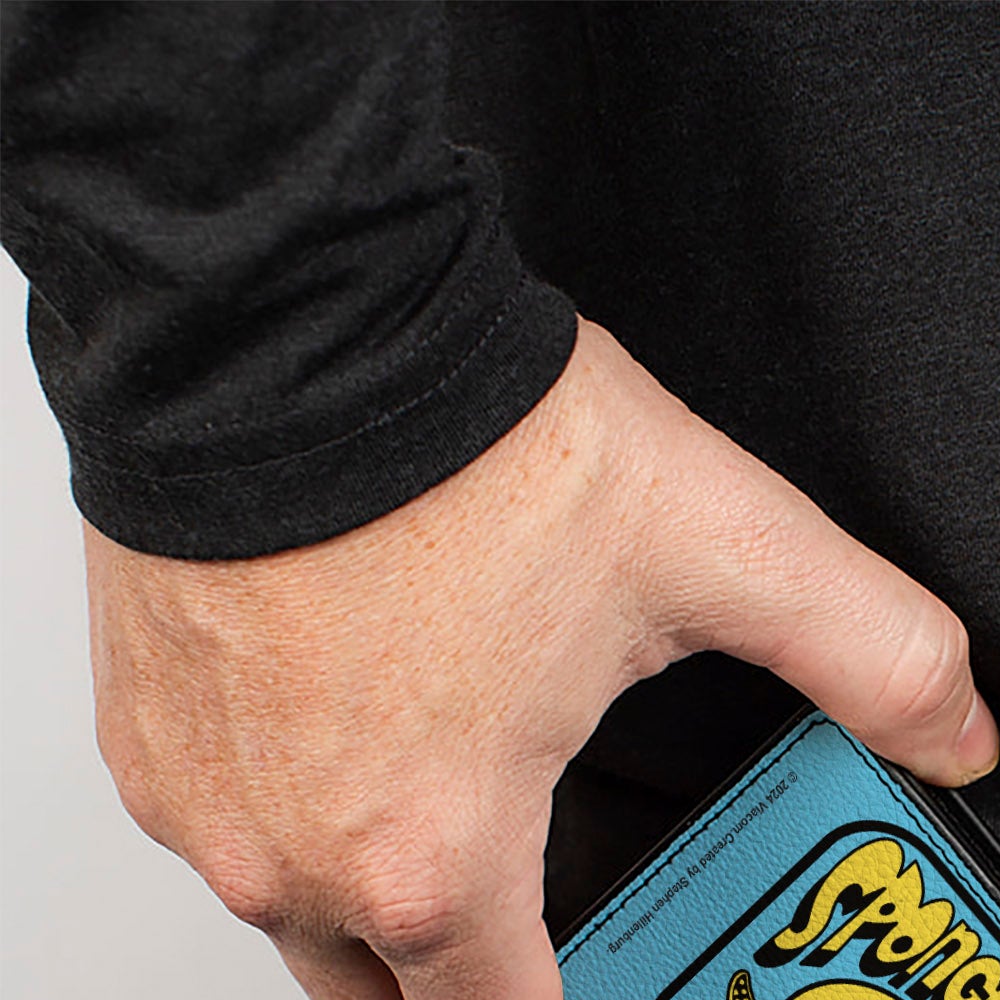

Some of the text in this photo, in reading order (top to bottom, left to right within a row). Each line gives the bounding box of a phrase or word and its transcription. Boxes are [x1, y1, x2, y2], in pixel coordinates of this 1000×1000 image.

[766, 779, 790, 805] 2024
[687, 864, 701, 879] by
[652, 876, 690, 912] Stephen
[606, 911, 655, 955] Hillenburg.
